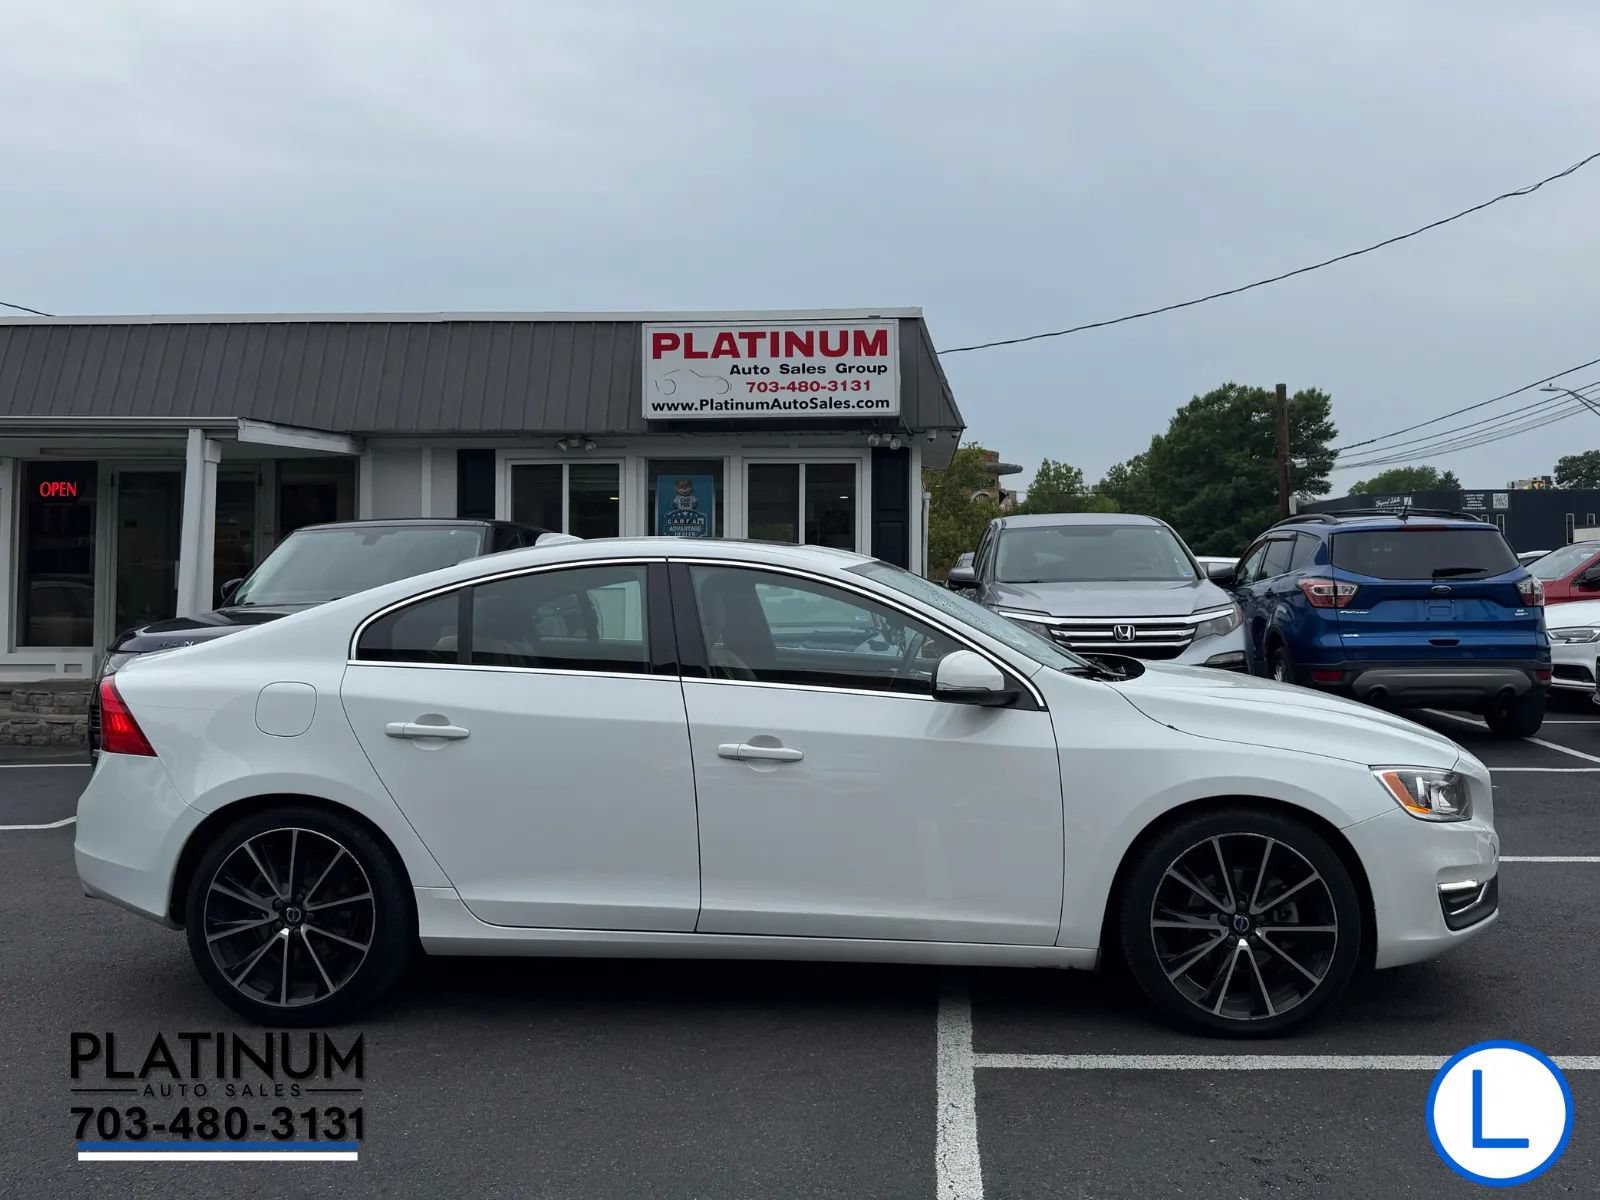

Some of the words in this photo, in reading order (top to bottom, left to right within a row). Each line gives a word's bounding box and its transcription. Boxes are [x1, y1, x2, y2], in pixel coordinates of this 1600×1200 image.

[652, 329, 888, 360] PLATINUM
[729, 364, 771, 376] Auto
[779, 363, 827, 375] Sales
[835, 363, 888, 375] Group
[745, 380, 872, 393] 703-480-3131
[651, 396, 890, 412] www.PlatinumAutoSales.com
[39, 481, 77, 497] OPEN
